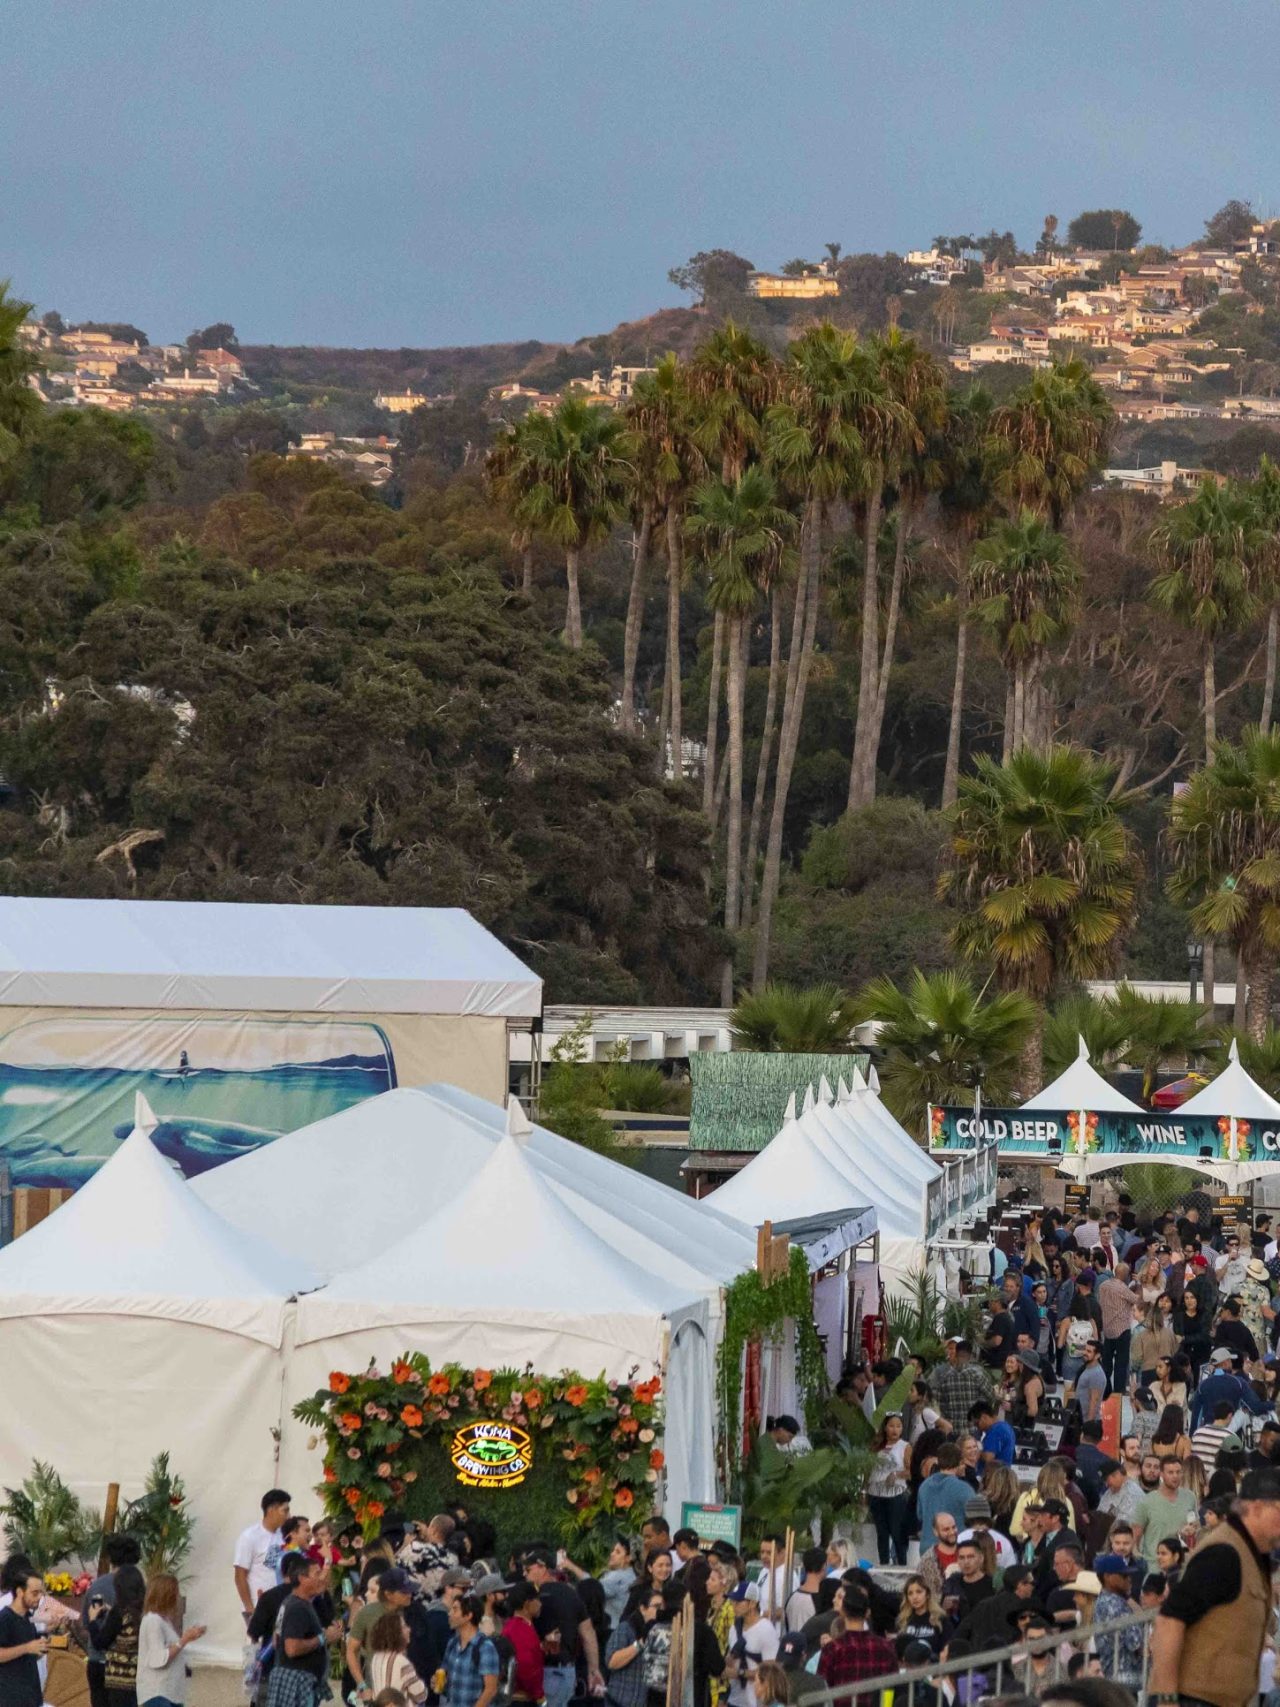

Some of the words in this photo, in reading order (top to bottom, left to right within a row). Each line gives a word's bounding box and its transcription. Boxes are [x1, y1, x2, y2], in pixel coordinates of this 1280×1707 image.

[956, 1118, 1007, 1139] COLD
[1011, 1120, 1058, 1141] BEER
[1136, 1124, 1187, 1145] WINE
[474, 1425, 512, 1440] KONA
[457, 1454, 509, 1475] BREWING
